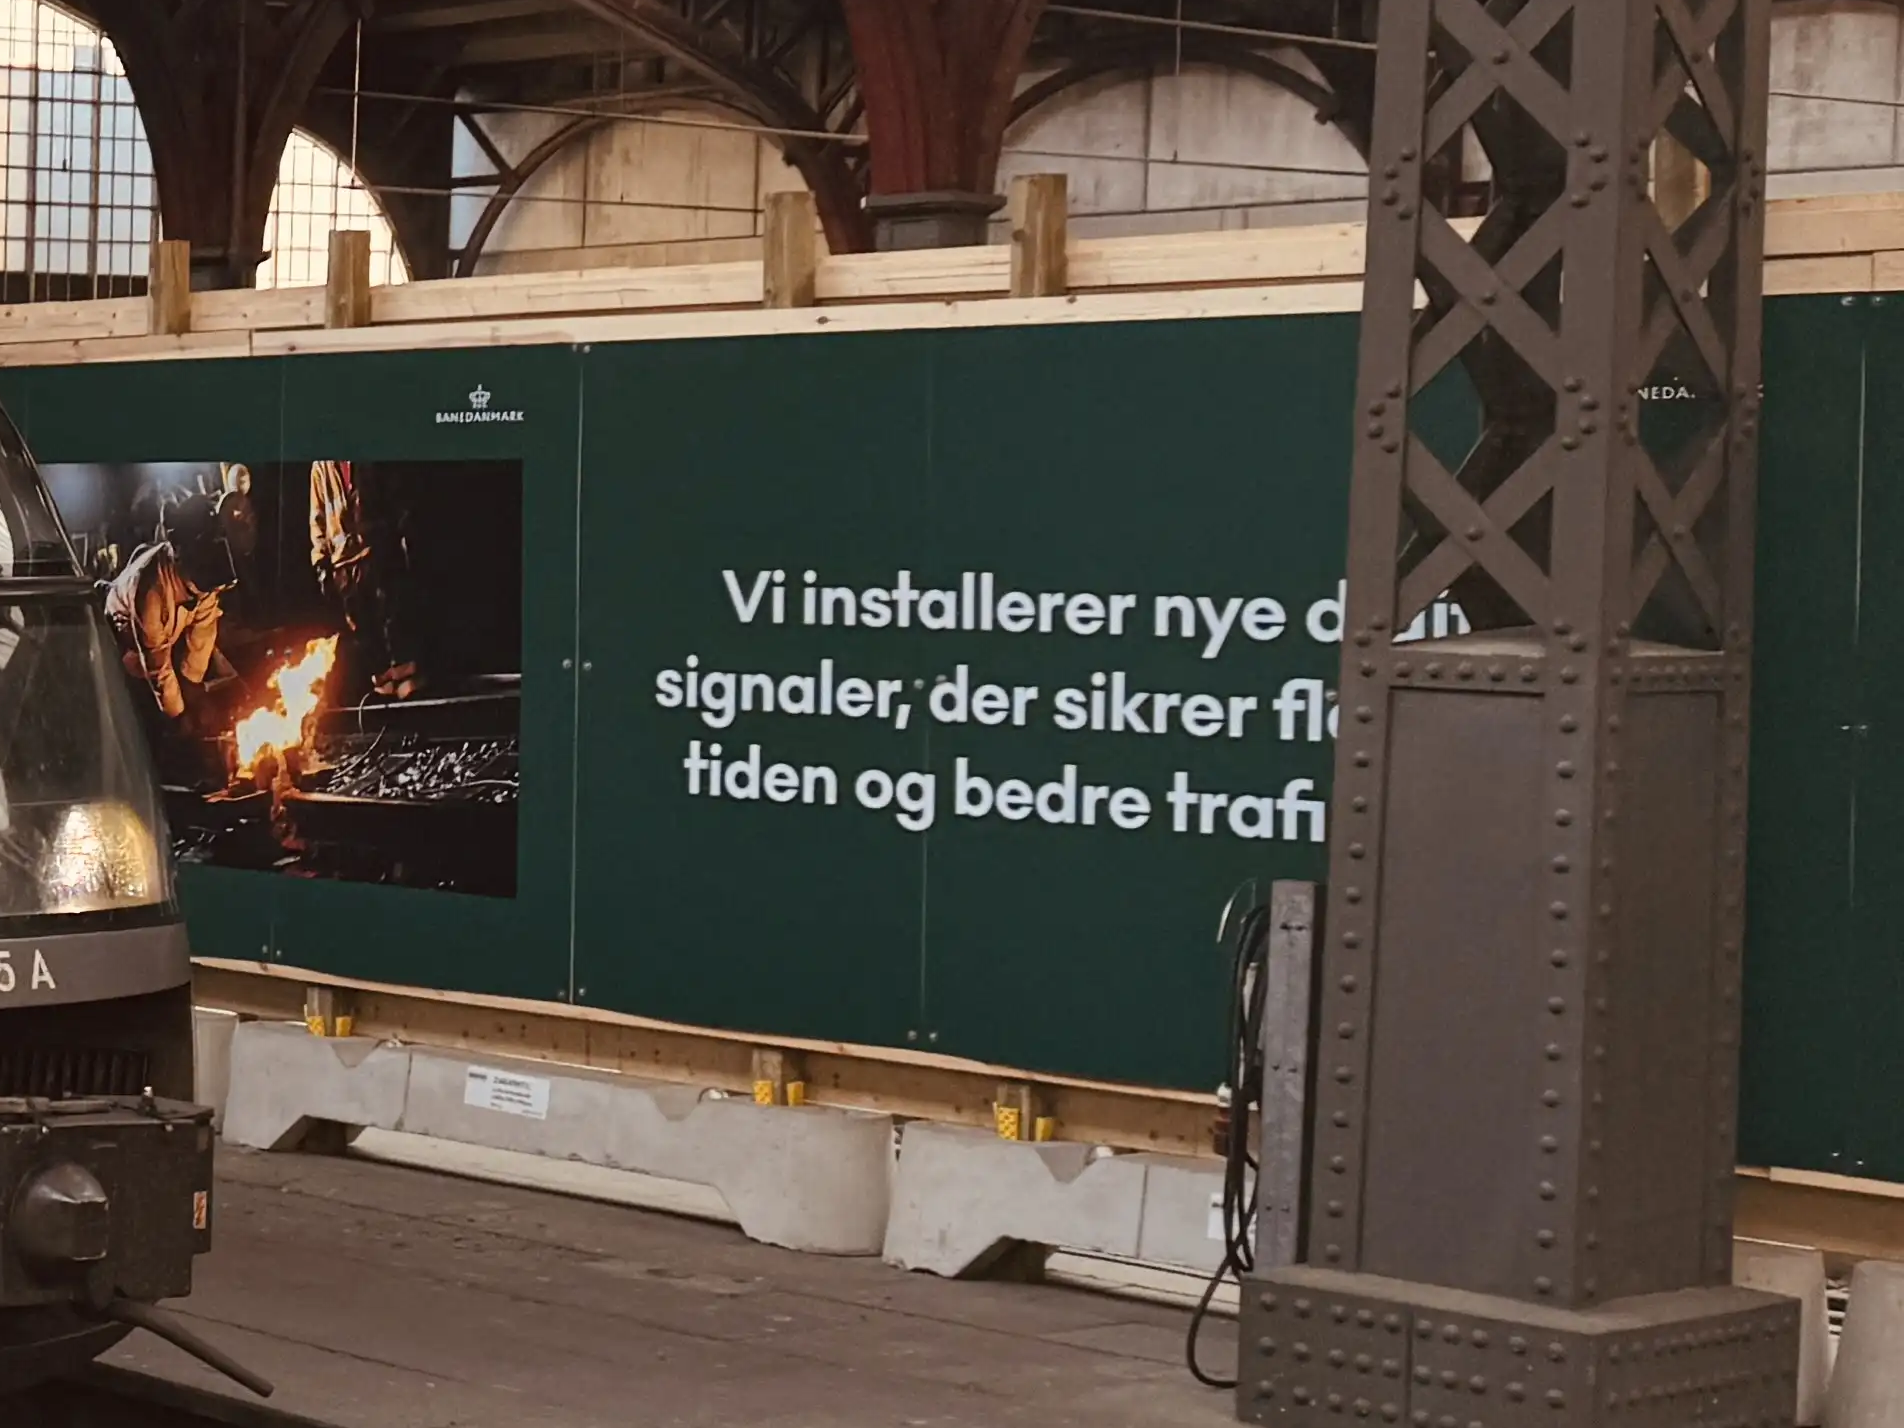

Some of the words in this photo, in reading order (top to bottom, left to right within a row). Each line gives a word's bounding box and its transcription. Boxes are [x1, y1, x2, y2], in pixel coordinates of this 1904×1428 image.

[722, 569, 786, 624] Vi
[803, 569, 1137, 636] installerer
[1154, 592, 1287, 660] nye
[655, 654, 912, 730] signaler,
[929, 664, 1039, 727] der
[1053, 671, 1258, 738] sikrer
[683, 739, 838, 805] tiden
[854, 769, 936, 832] og
[954, 756, 1152, 831] bedre
[31, 949, 57, 990] A
